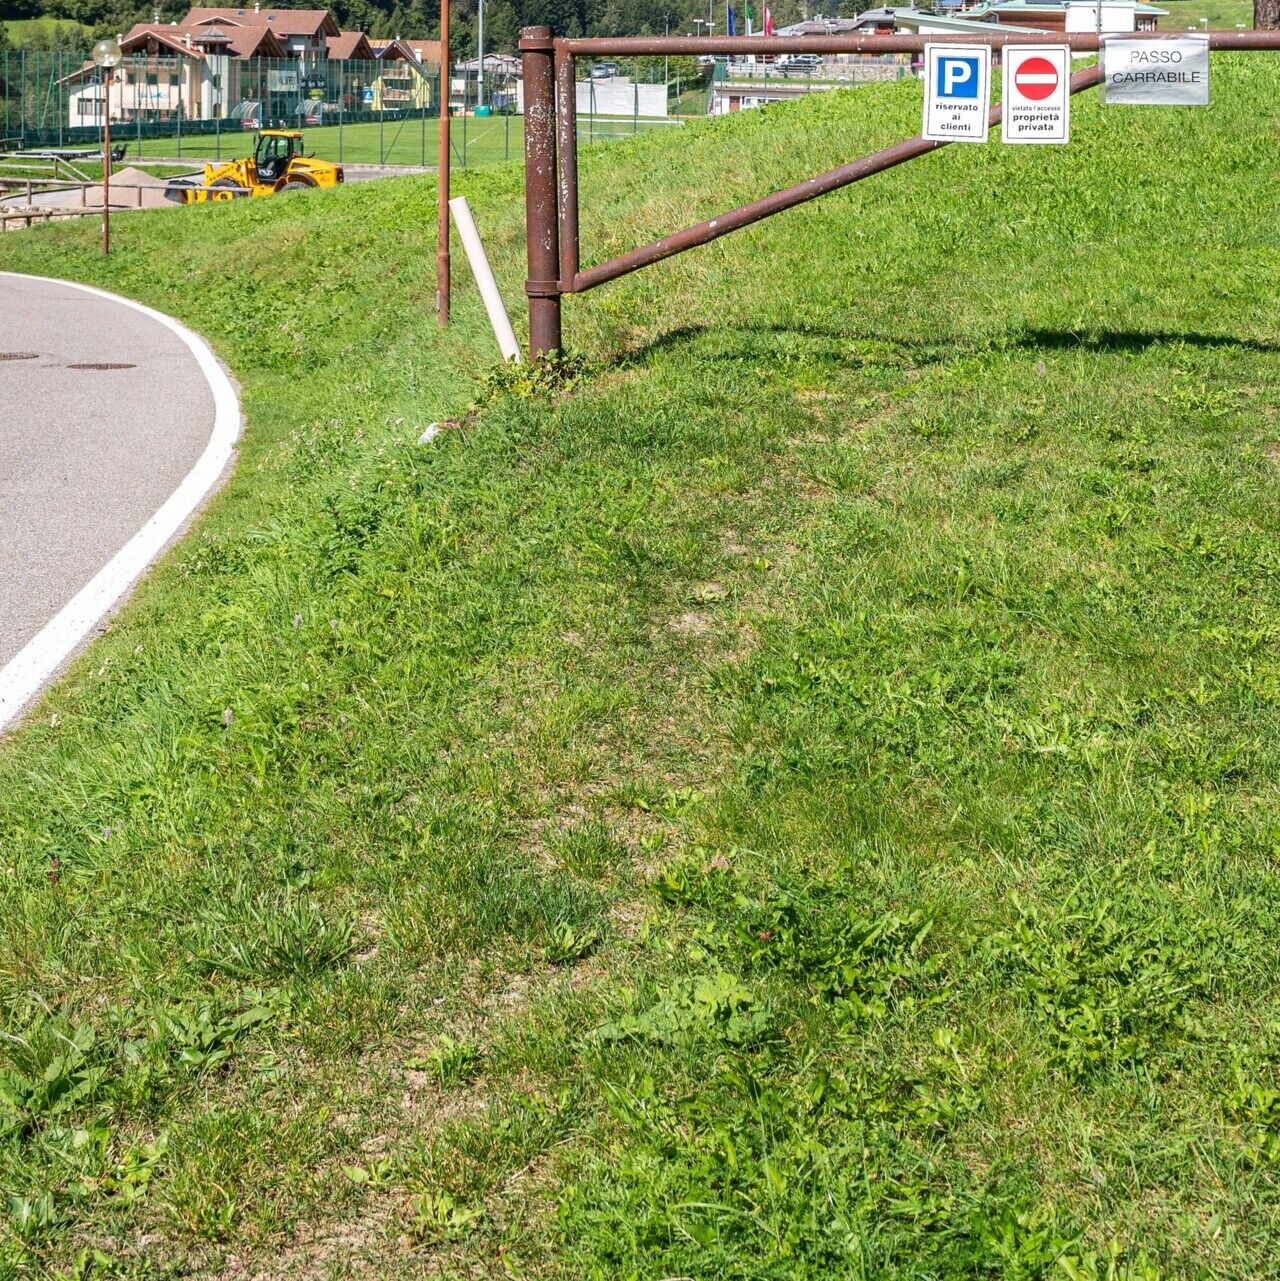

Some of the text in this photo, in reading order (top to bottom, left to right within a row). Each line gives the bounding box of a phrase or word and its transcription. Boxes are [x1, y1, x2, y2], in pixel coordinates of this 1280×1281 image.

[1129, 50, 1183, 63] PASSO
[943, 60, 972, 95] P
[1112, 71, 1201, 84] CARRABILE
[935, 102, 979, 111] riservato
[951, 113, 961, 121] ai
[1013, 112, 1060, 122] proprietà
[940, 123, 971, 131] clienti
[1018, 123, 1054, 132] privata
